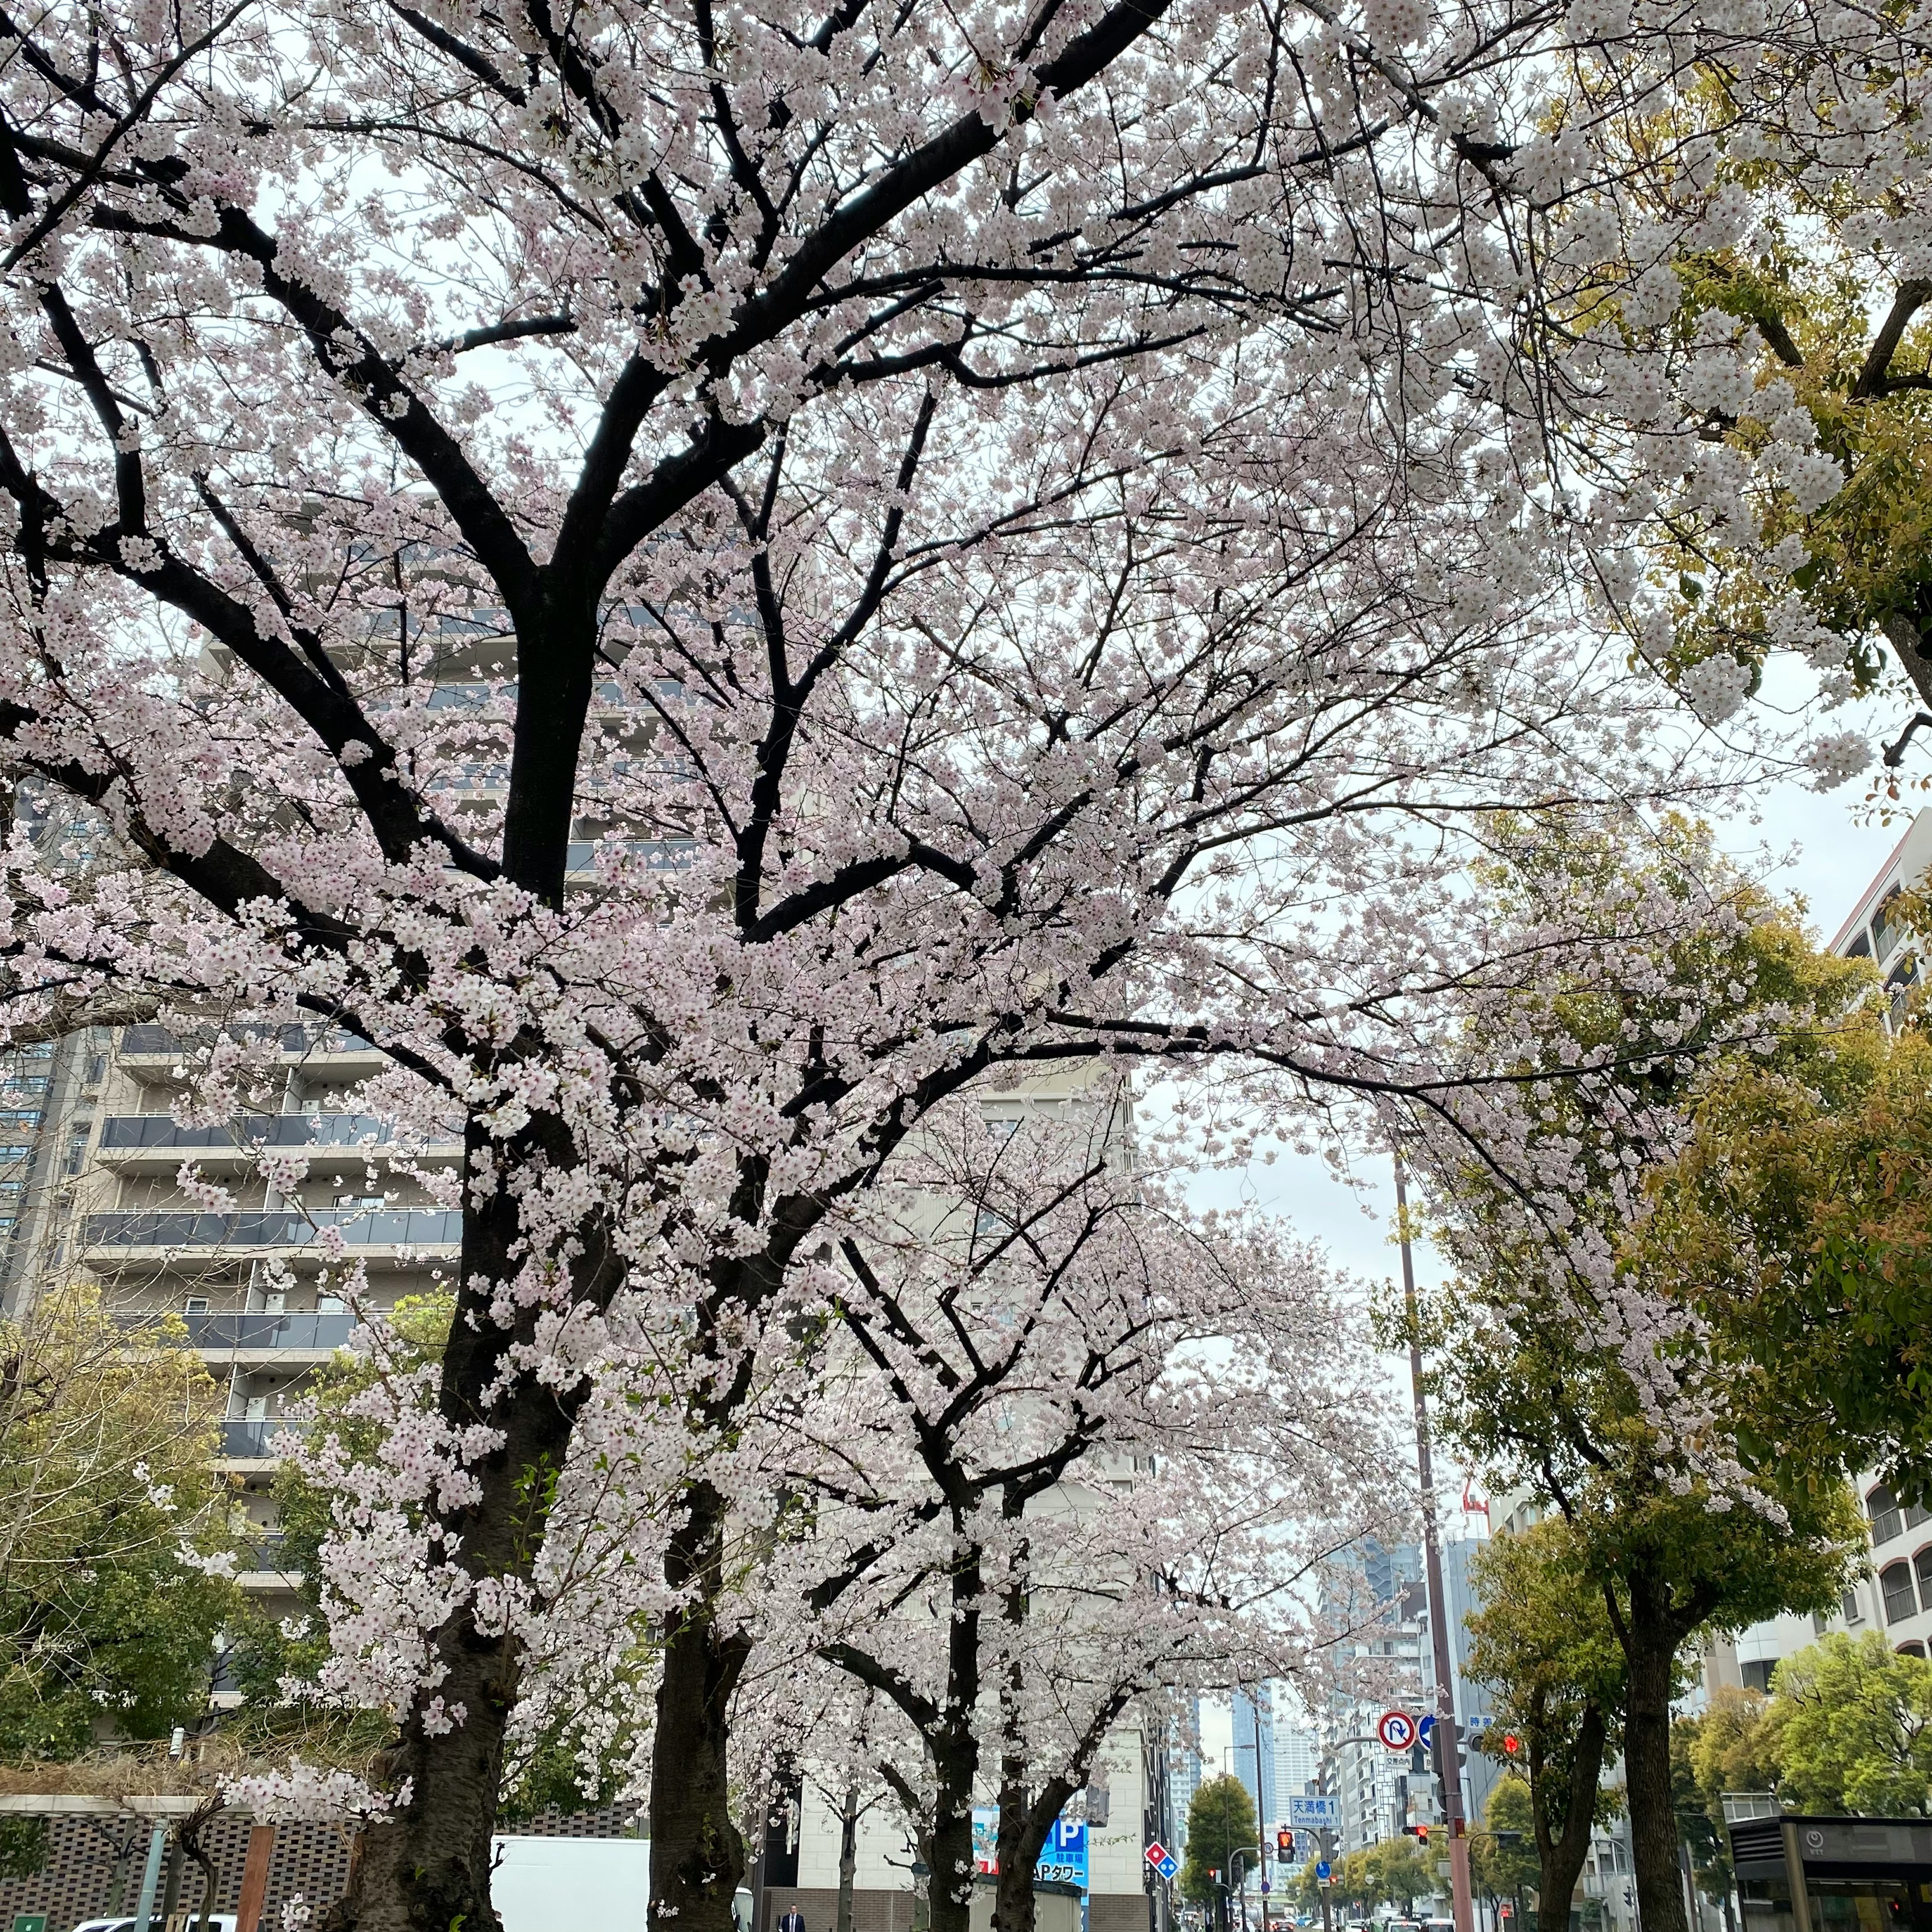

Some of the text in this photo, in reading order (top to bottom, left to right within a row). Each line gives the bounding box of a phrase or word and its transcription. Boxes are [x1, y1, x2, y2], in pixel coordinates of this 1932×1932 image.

[1294, 1800, 1334, 1814] 天満橋 1
[1294, 1816, 1332, 1824] Tenmabashi
[1060, 1818, 1079, 1847] P
[1057, 1853, 1083, 1864] 駐車場
